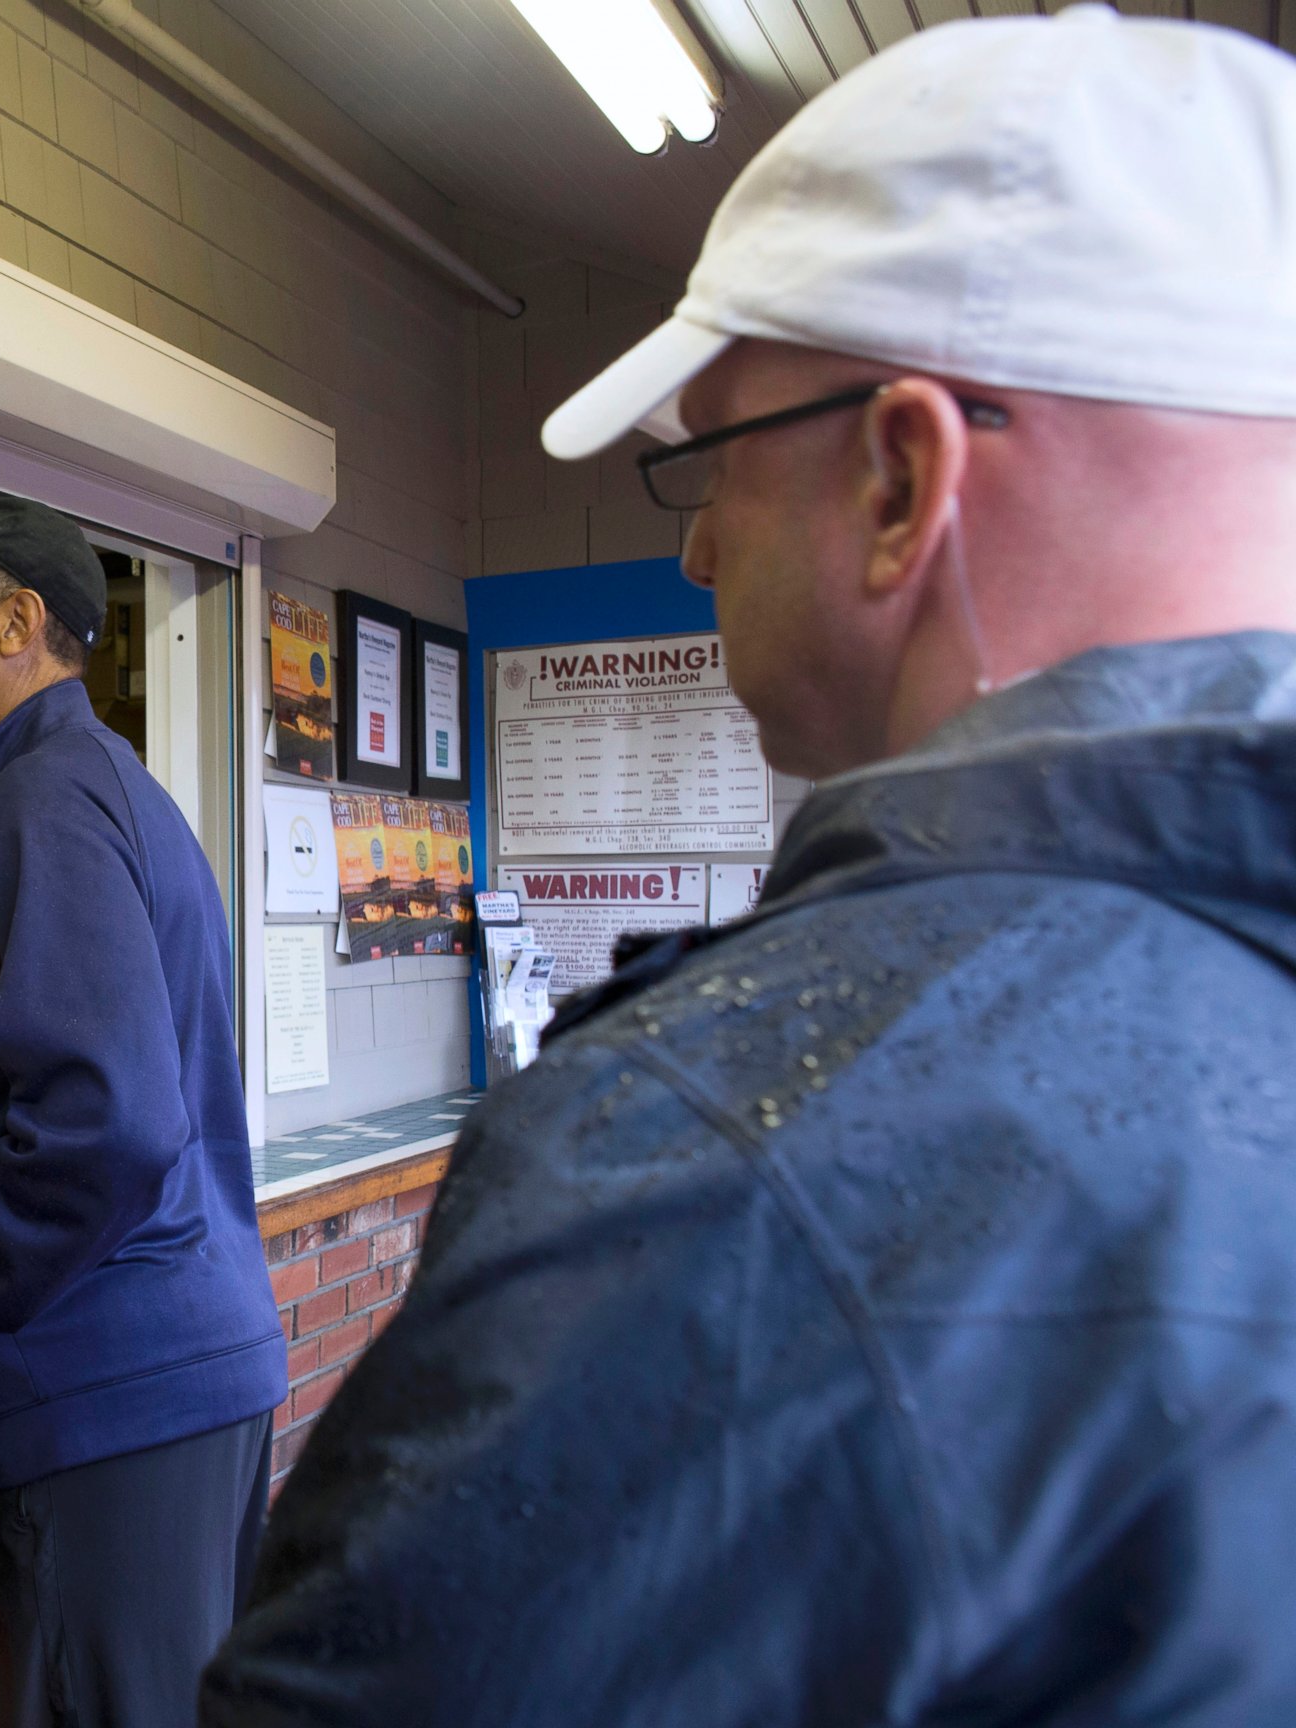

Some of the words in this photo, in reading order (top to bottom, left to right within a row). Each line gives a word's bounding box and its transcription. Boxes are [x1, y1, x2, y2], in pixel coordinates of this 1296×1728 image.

[272, 599, 292, 616] CAPE
[276, 613, 292, 630] COD
[291, 607, 324, 642] LIFE
[555, 678, 621, 692] CRIMINAL
[626, 672, 701, 688] VIOLATION
[523, 702, 556, 710] PENALTIES
[558, 700, 571, 708] FOR
[574, 699, 586, 707] THE
[588, 698, 610, 706] CRIME
[625, 695, 655, 704] DRIVING
[658, 694, 680, 702] UNDER
[699, 689, 736, 698] INFLUENC
[334, 803, 350, 814] CAPE
[384, 803, 400, 815] CAPE
[337, 815, 352, 826] COD
[350, 803, 378, 827] LIFE
[400, 804, 427, 829] LIFE
[430, 810, 443, 821] CAPE
[387, 816, 401, 826] COD
[443, 812, 466, 837] LIFE
[433, 823, 444, 833] COD
[669, 826, 697, 834] punished
[699, 826, 707, 834] by
[724, 841, 767, 849] COMMISSION
[542, 918, 559, 926] upon
[561, 918, 574, 926] any
[576, 918, 590, 926] way
[611, 918, 624, 926] any
[626, 917, 647, 926] place
[659, 917, 682, 925] which
[553, 925, 569, 933] right
[621, 925, 640, 933] upon
[551, 948, 582, 956] beverage
